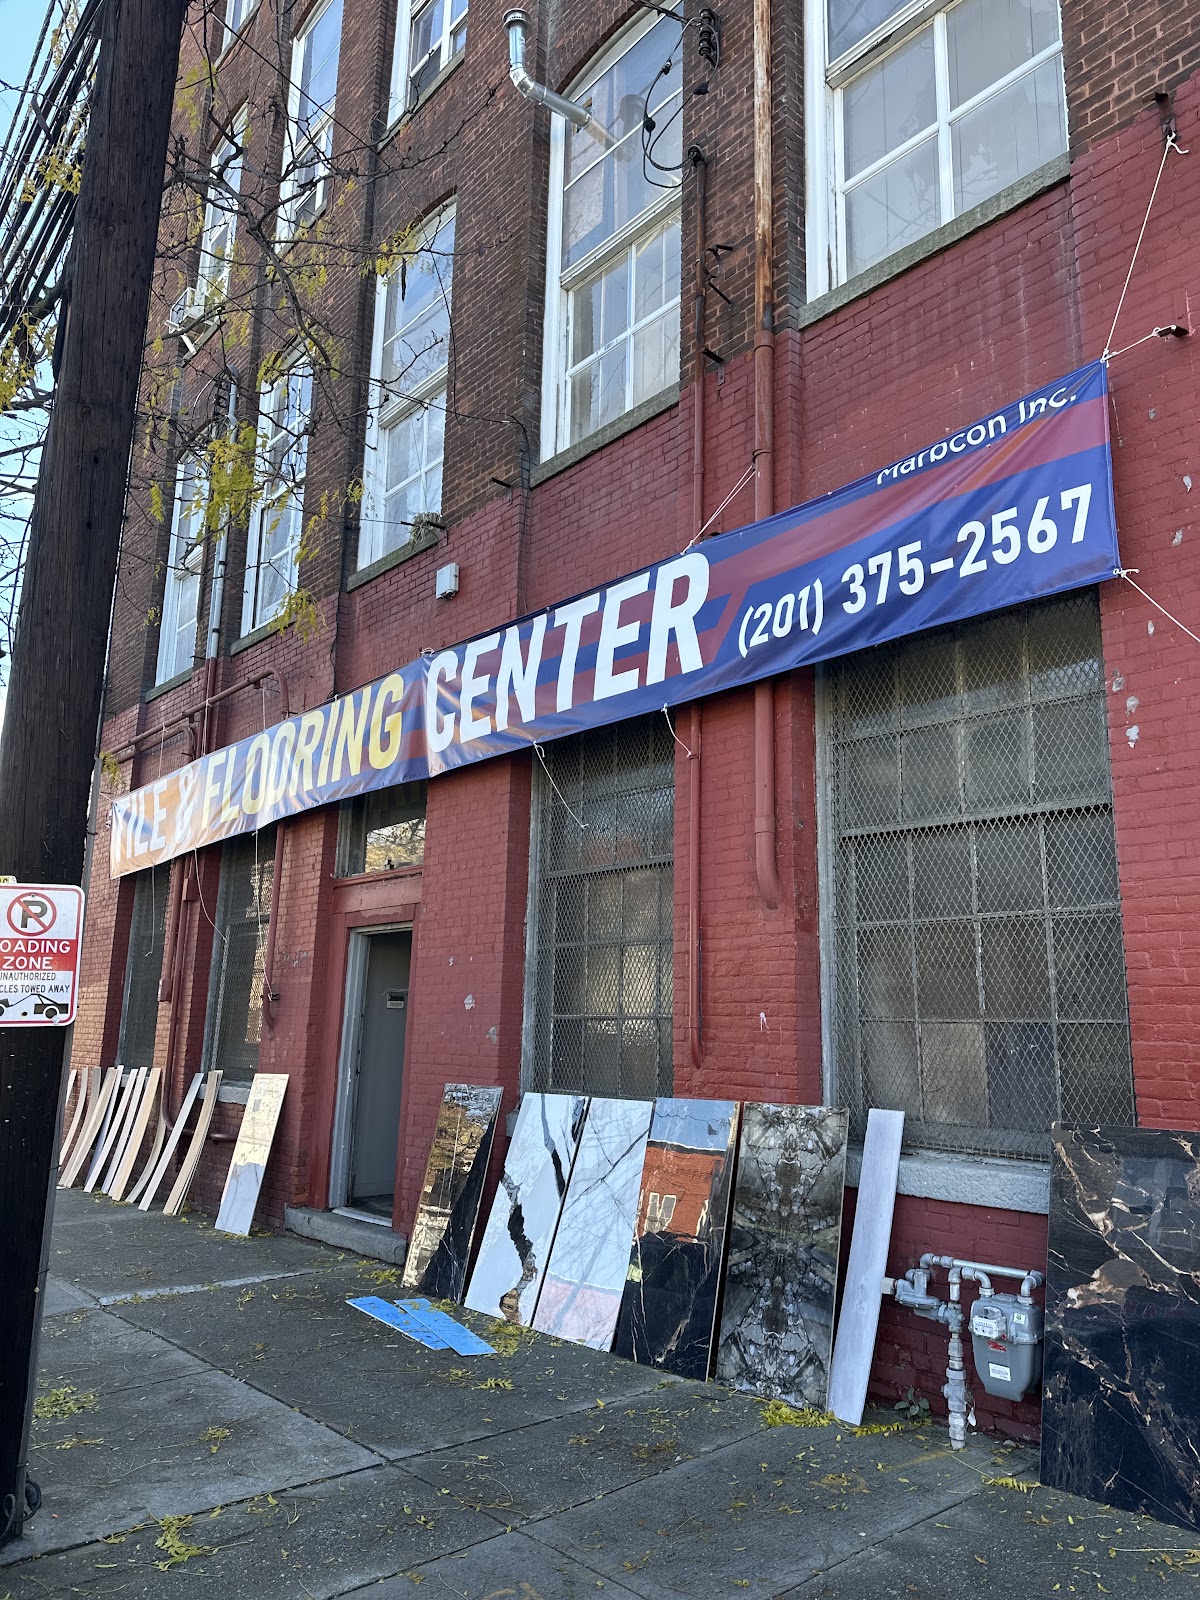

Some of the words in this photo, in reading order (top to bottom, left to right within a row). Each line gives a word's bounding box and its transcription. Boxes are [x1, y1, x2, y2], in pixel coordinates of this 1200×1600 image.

[1018, 387, 1077, 424] Inc.
[738, 577, 824, 659] (201)
[841, 483, 1092, 614] 375-2567
[114, 777, 168, 863] TILE
[174, 764, 195, 845] &
[200, 673, 405, 832] FLOORING
[426, 552, 710, 754] CENTER
[0, 939, 71, 954] OADING
[2, 956, 54, 970] ZONE
[0, 984, 19, 993] CLES
[20, 984, 46, 993] TOWED
[47, 984, 71, 993] AWAY
